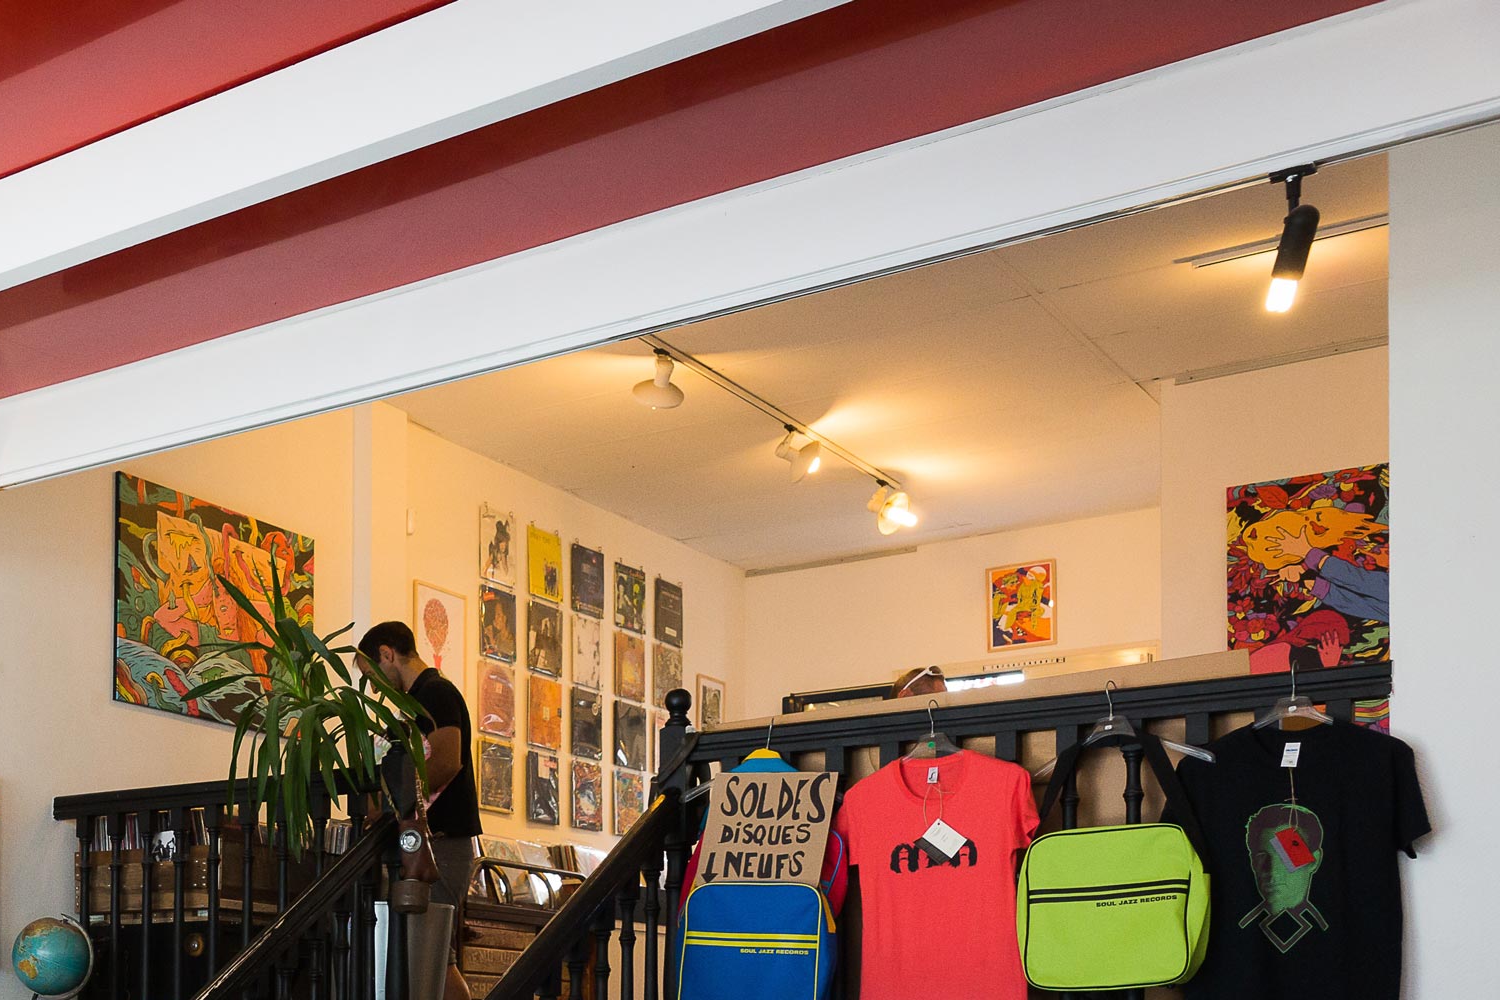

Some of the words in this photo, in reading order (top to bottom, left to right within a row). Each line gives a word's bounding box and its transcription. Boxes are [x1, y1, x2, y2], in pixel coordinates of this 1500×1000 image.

[720, 773, 830, 823] SOLDES
[723, 851, 805, 879] NEUFS
[1140, 895, 1177, 904] RECORDS
